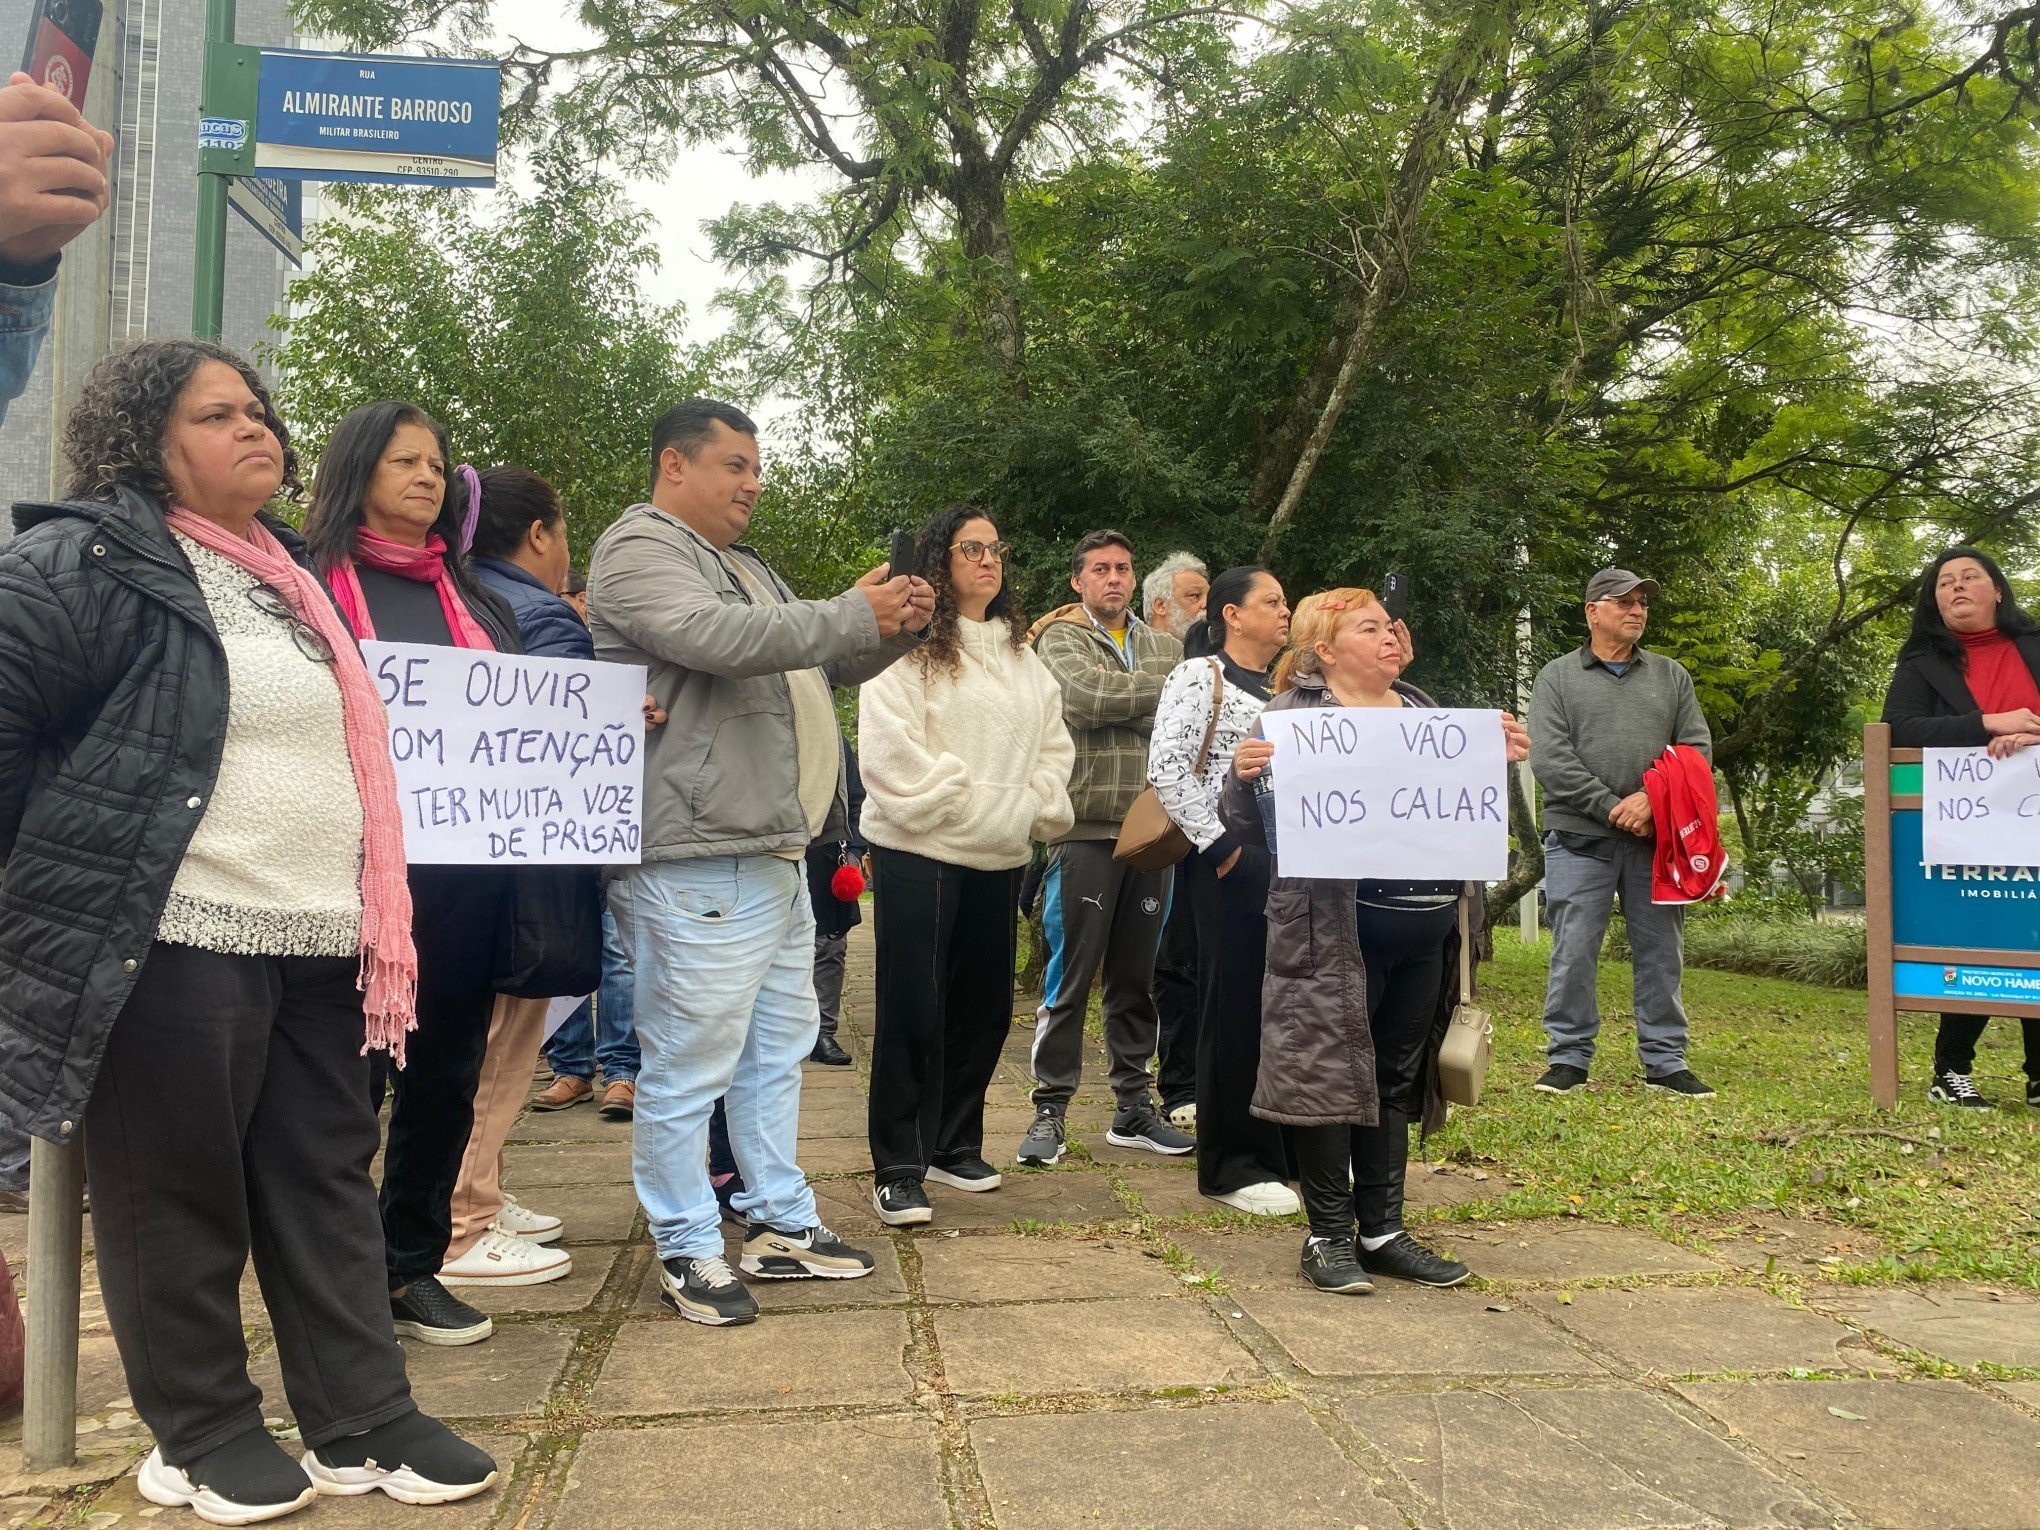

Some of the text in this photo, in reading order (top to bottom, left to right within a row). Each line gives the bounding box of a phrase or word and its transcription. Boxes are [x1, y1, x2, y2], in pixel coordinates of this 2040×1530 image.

[359, 69, 376, 80] RUA
[282, 90, 473, 124] ALMIRANTE BARROSO
[319, 126, 400, 140] MILITAR BRASILEIRO
[377, 654, 591, 720] SE OUVIR
[392, 722, 636, 779] OM ATENÇÃO
[1291, 712, 1467, 759] NÃO VÃO
[1937, 752, 1993, 783] NÃO
[411, 783, 634, 830] TER MUITA VOZ
[1301, 785, 1501, 829] NOS CALAR
[1938, 796, 1990, 821] NOS
[488, 818, 640, 858] DE PRISÃO
[1919, 861, 2040, 881] TERRA
[1962, 975, 2002, 988] NOVO
